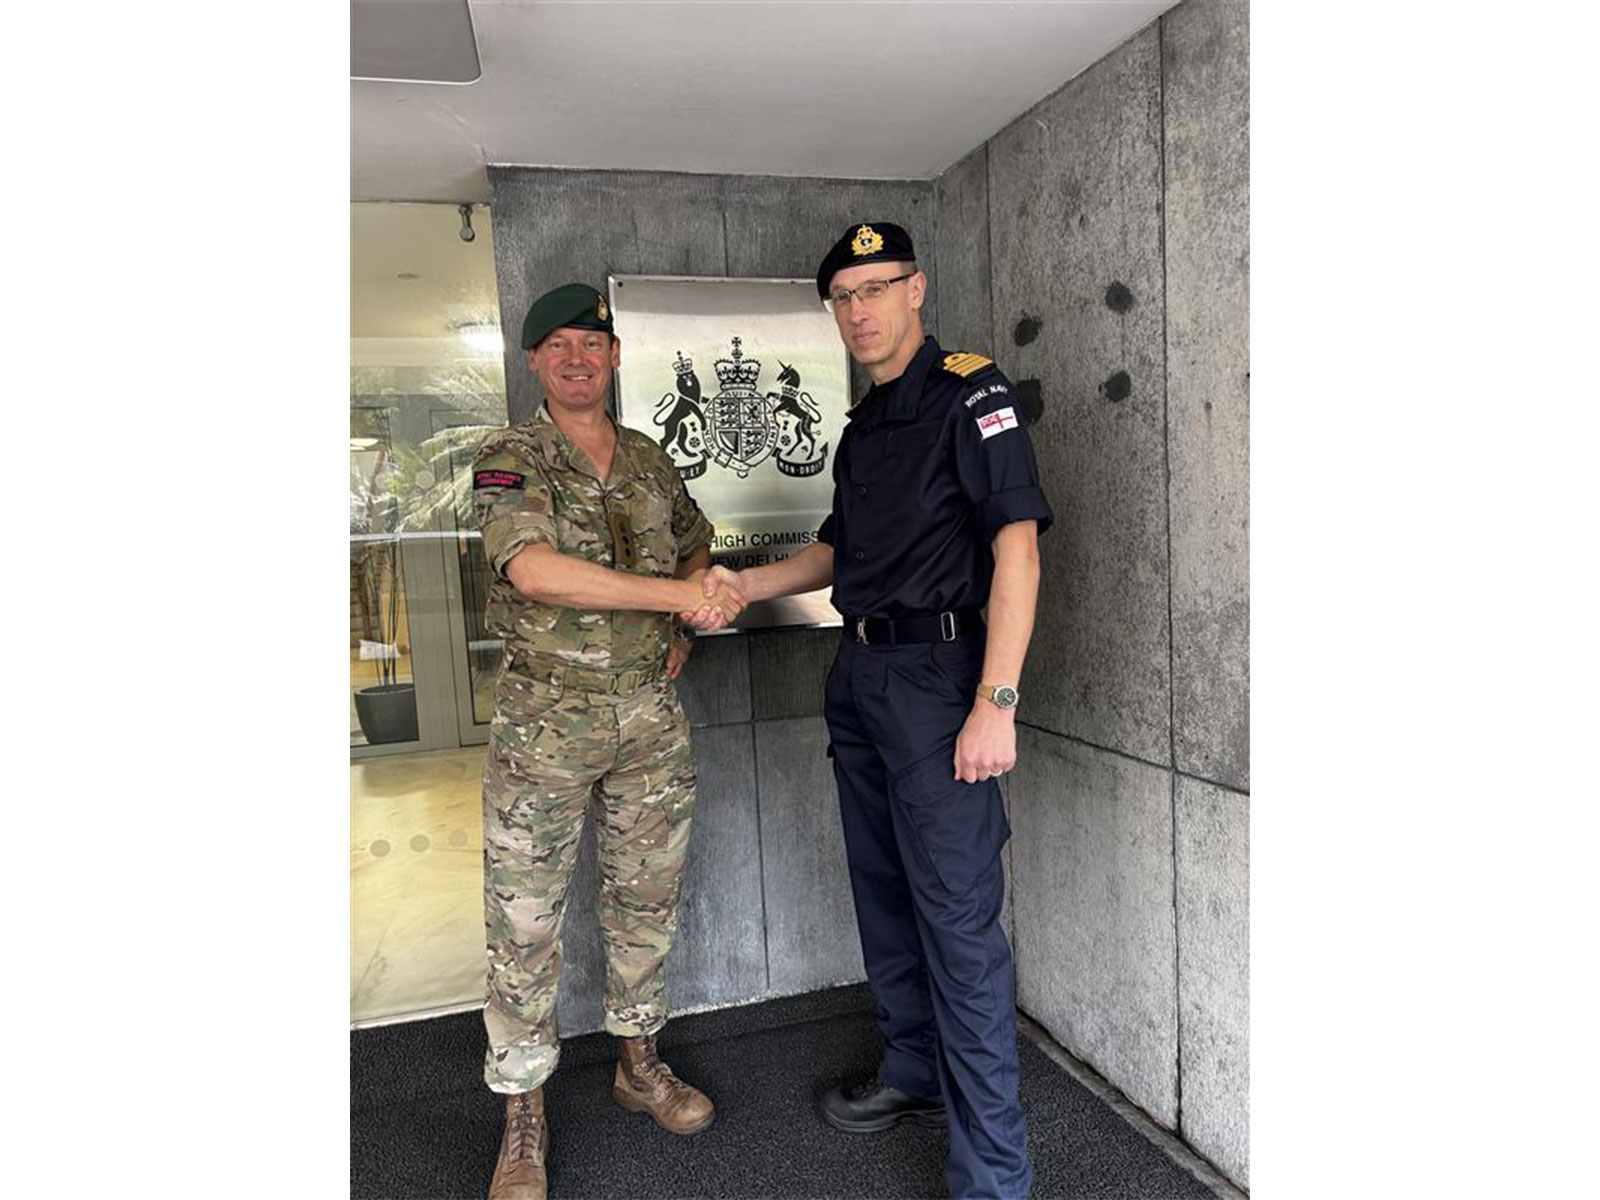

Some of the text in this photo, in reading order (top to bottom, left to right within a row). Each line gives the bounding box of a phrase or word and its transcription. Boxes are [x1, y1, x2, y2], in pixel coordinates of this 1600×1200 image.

[964, 389, 988, 408] ROYAL
[709, 530, 819, 548] HIGH COMMISS
